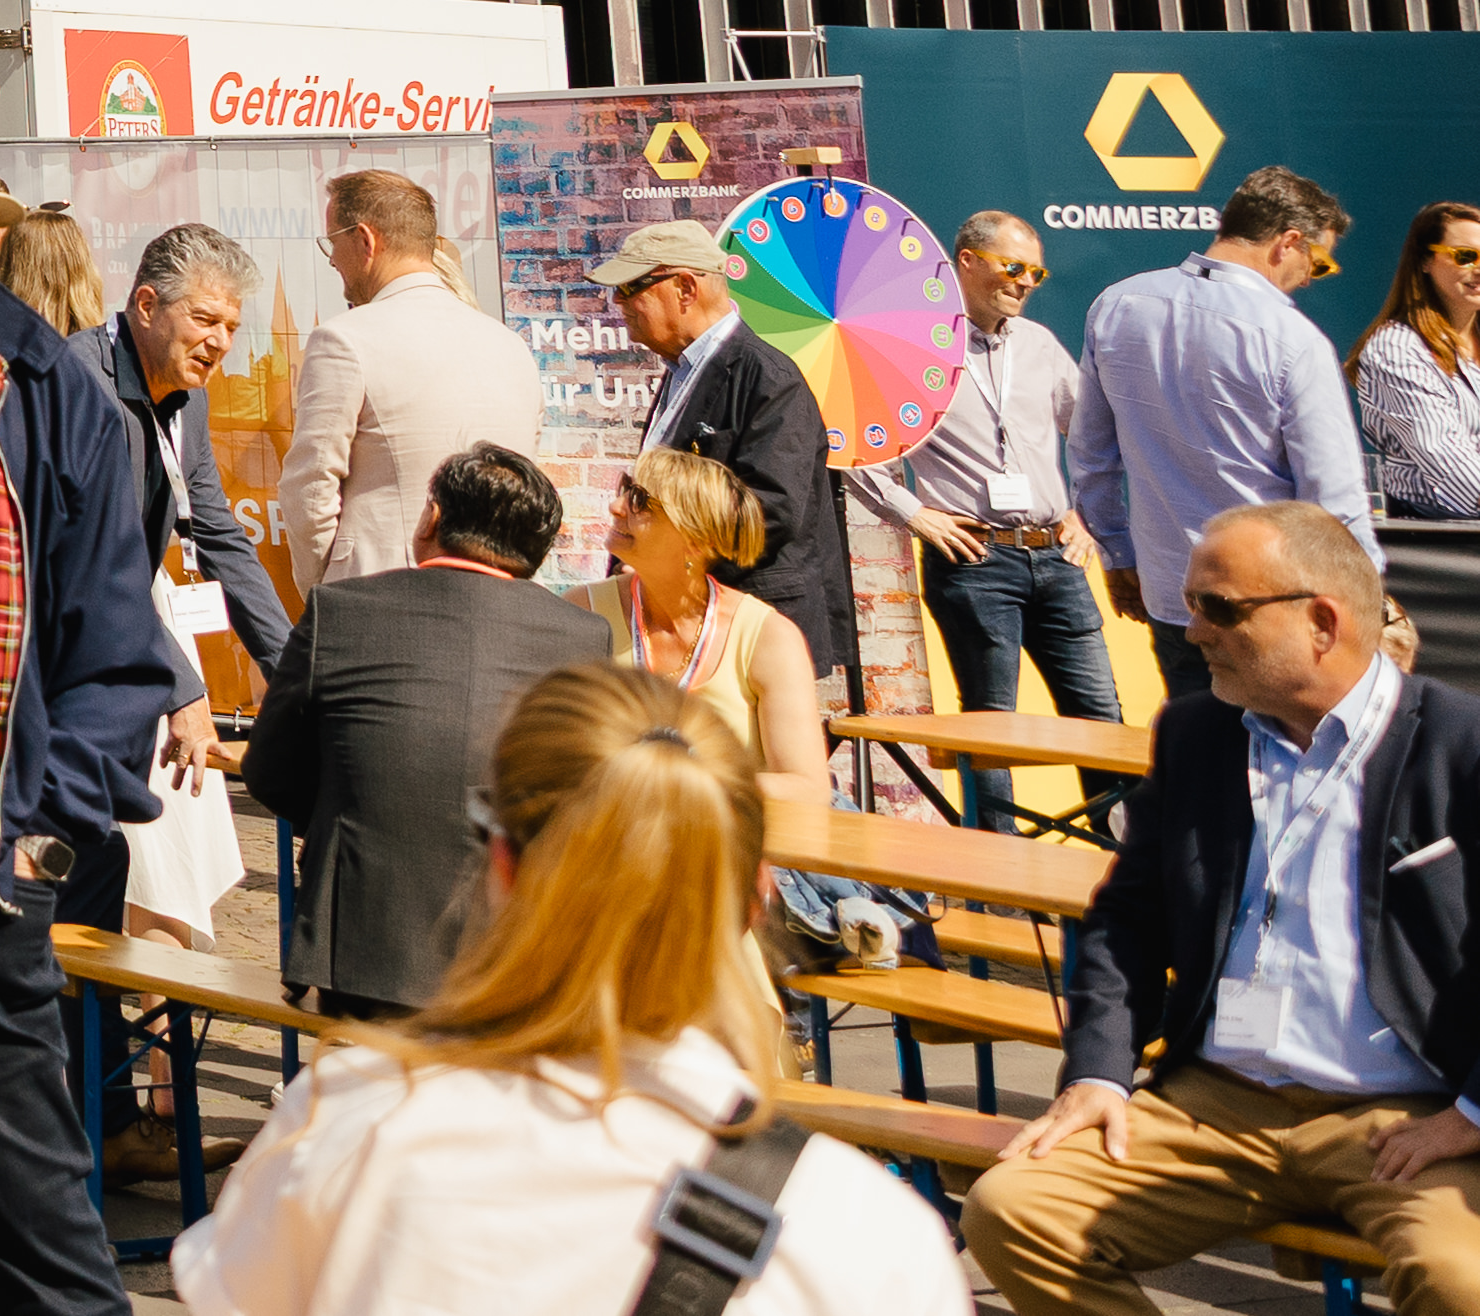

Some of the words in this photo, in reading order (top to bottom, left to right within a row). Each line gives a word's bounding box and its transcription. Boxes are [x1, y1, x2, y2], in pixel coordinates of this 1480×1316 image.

[622, 183, 741, 201] COMMERZBANK
[1043, 204, 1221, 232] COMMERZB
[936, 328, 948, 344] 11
